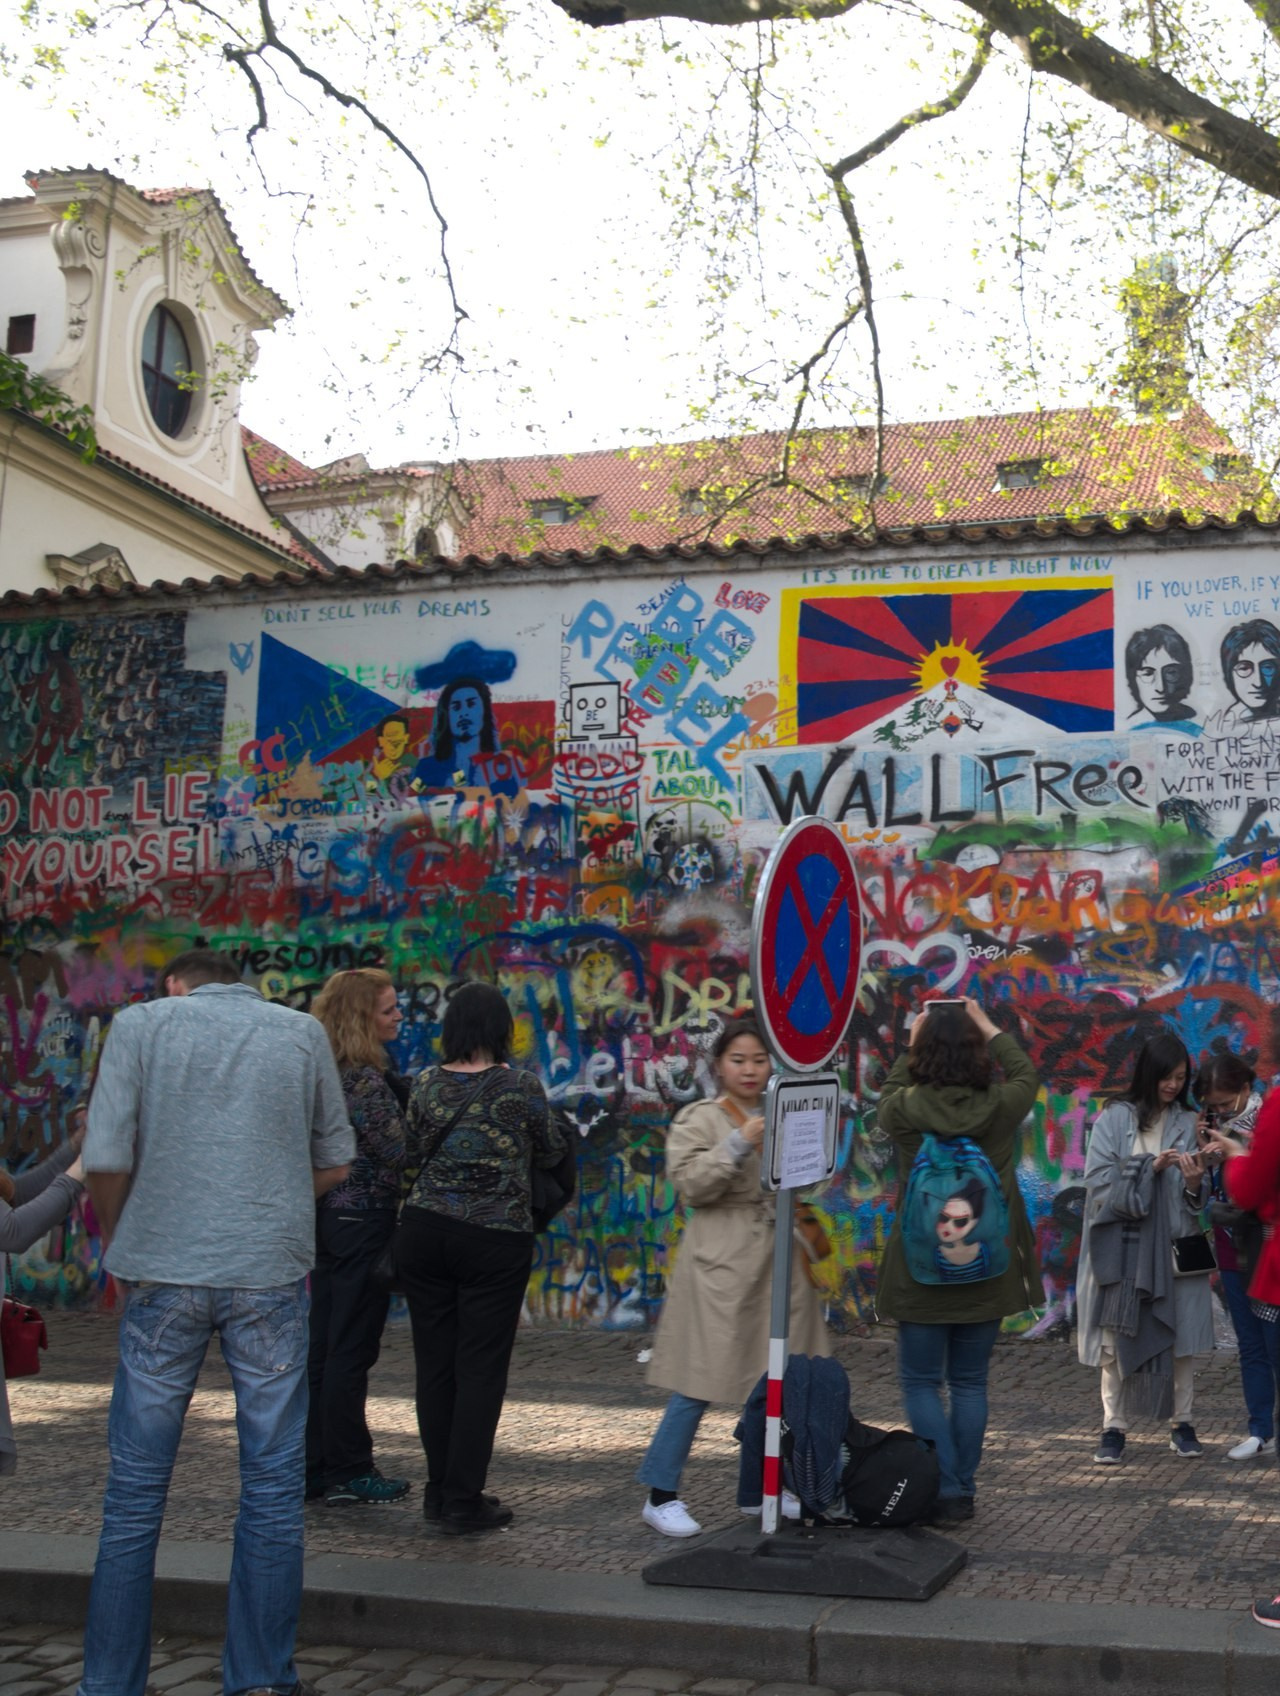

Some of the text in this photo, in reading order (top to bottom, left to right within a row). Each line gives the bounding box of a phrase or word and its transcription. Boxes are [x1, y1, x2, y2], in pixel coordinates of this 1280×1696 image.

[851, 565, 893, 581] TIME
[902, 565, 922, 580] TO
[928, 559, 999, 580] CREATE
[1009, 558, 1057, 574] RIGHT
[1069, 556, 1113, 571] NOW
[1137, 580, 1153, 600] IF
[1161, 579, 1192, 599] YOU
[1251, 577, 1264, 592] IF
[318, 607, 355, 621] SELL
[363, 600, 401, 617] YOUR
[417, 599, 491, 618] DREAMS
[1184, 601, 1214, 618] WE
[1223, 598, 1261, 616] LOVE
[1210, 737, 1250, 756] THE
[1187, 755, 1216, 771] WE
[755, 747, 985, 828] WALL
[1160, 774, 1214, 795] WITH
[1222, 772, 1252, 791] THE
[30, 786, 113, 833] NOT
[132, 771, 212, 825] LIE
